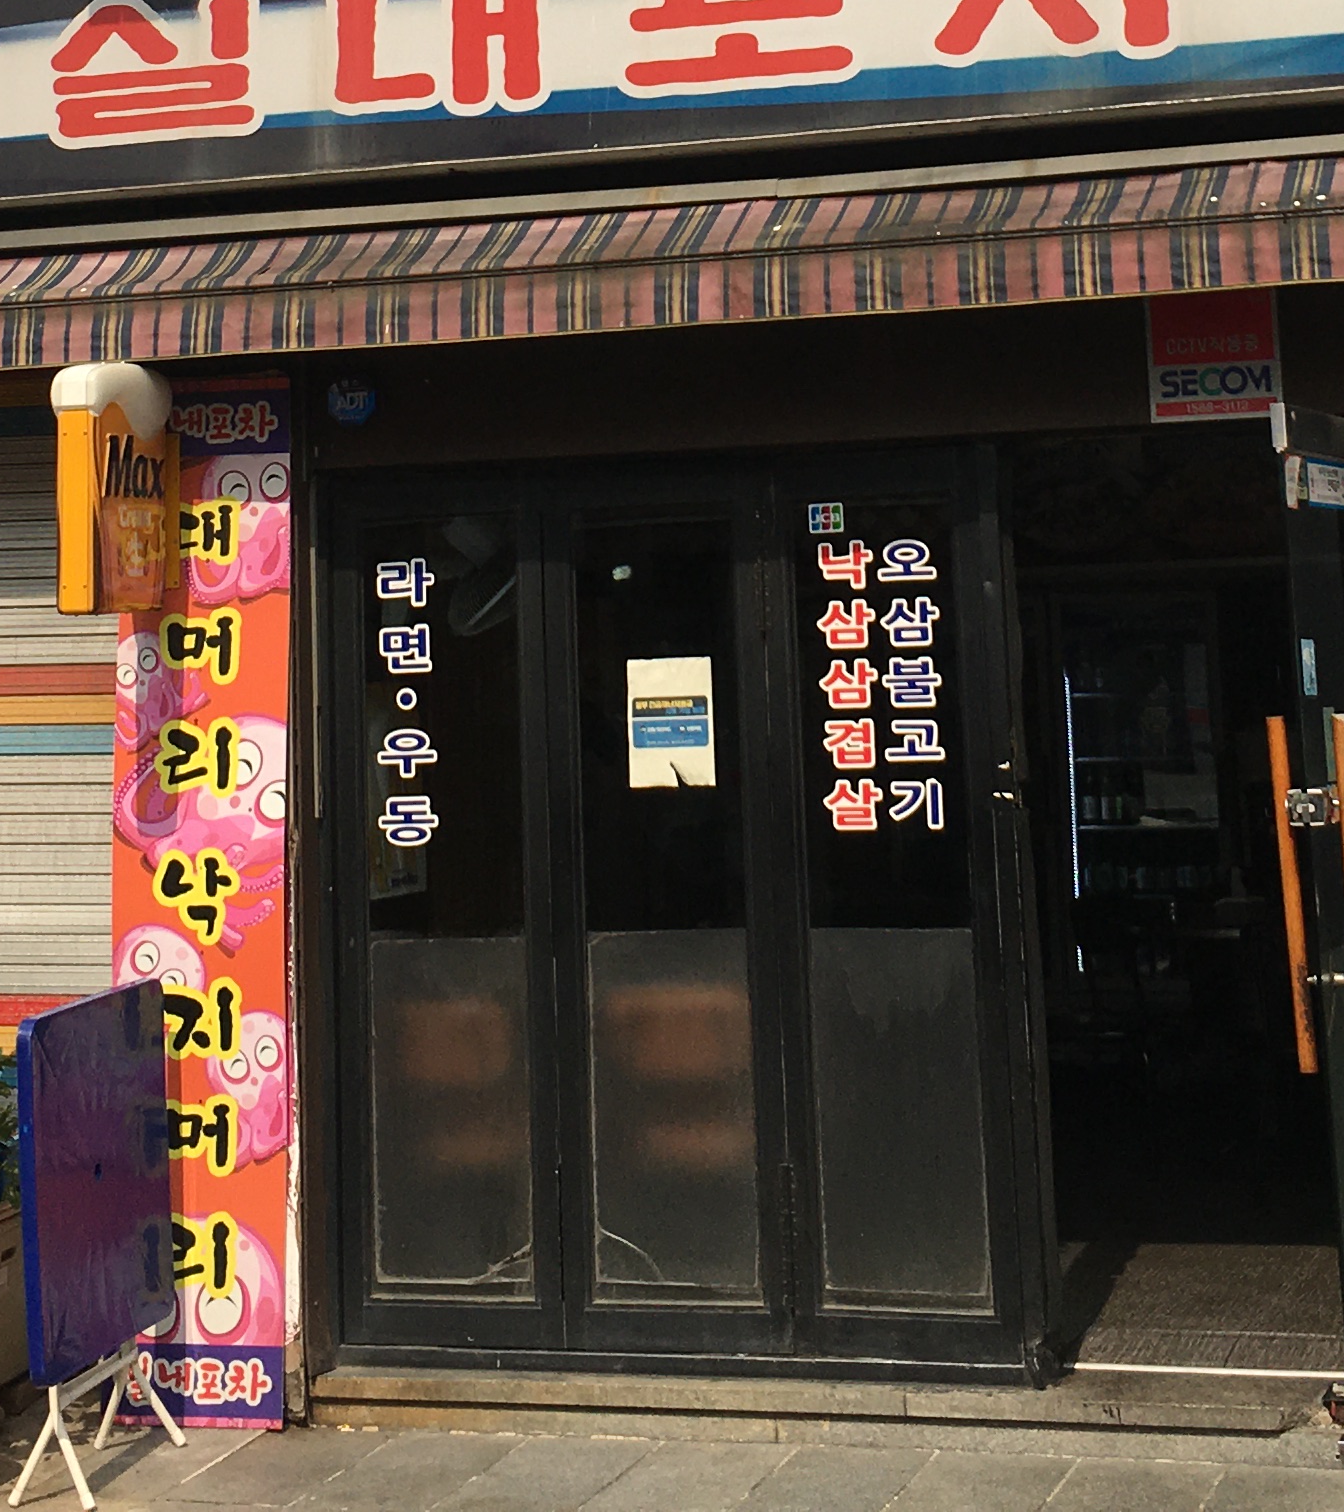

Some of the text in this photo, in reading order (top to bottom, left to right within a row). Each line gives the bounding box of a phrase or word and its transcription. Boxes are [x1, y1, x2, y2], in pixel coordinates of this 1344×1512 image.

[1159, 364, 1273, 398] SECOM
[171, 402, 277, 443] 내포차
[102, 434, 165, 500] Max
